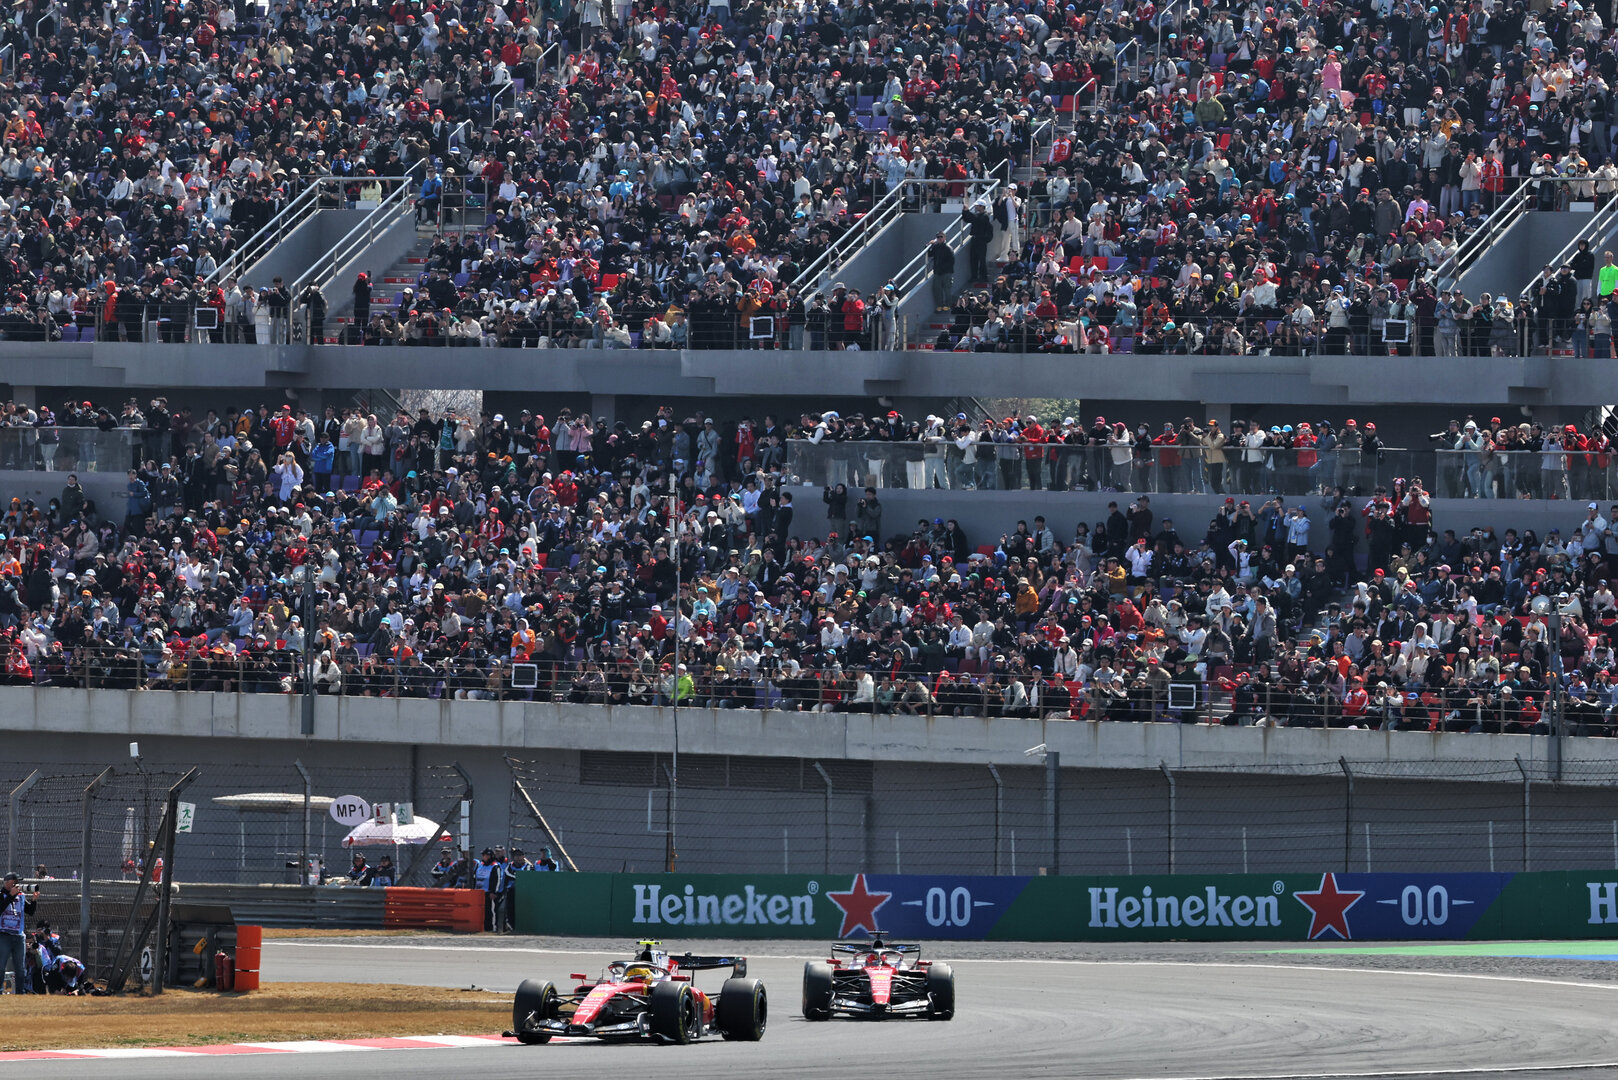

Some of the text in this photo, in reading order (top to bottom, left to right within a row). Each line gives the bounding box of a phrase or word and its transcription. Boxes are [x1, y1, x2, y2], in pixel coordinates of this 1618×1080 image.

[336, 804, 365, 817] MP1
[925, 886, 971, 927] 0.0
[1401, 885, 1449, 926] 0.0
[142, 951, 150, 974] 2
